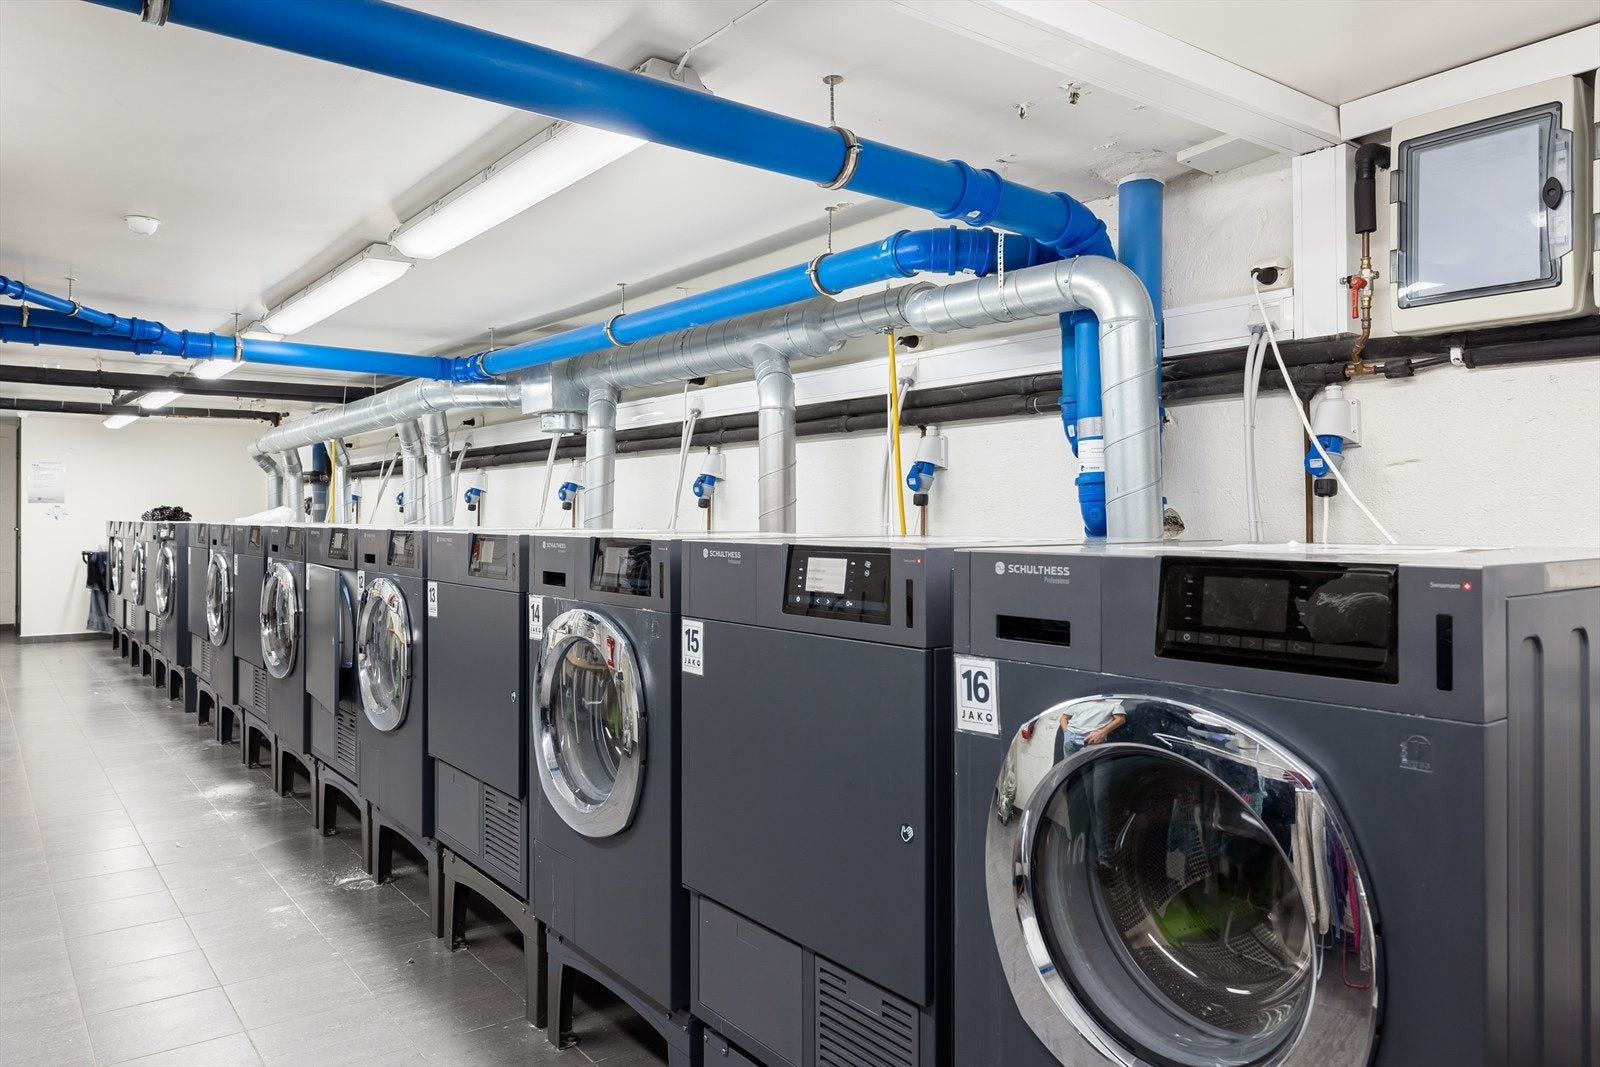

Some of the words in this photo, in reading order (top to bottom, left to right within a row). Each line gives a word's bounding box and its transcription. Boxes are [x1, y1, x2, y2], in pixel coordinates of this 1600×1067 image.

[709, 550, 741, 559] SCHULTHESS
[1008, 564, 1070, 576] SCHULTHESS
[429, 587, 436, 603] 13
[530, 603, 540, 623] 14
[685, 628, 700, 653] 15
[684, 658, 701, 667] JAKO
[961, 669, 990, 704] 16
[962, 709, 993, 723] JAKO
